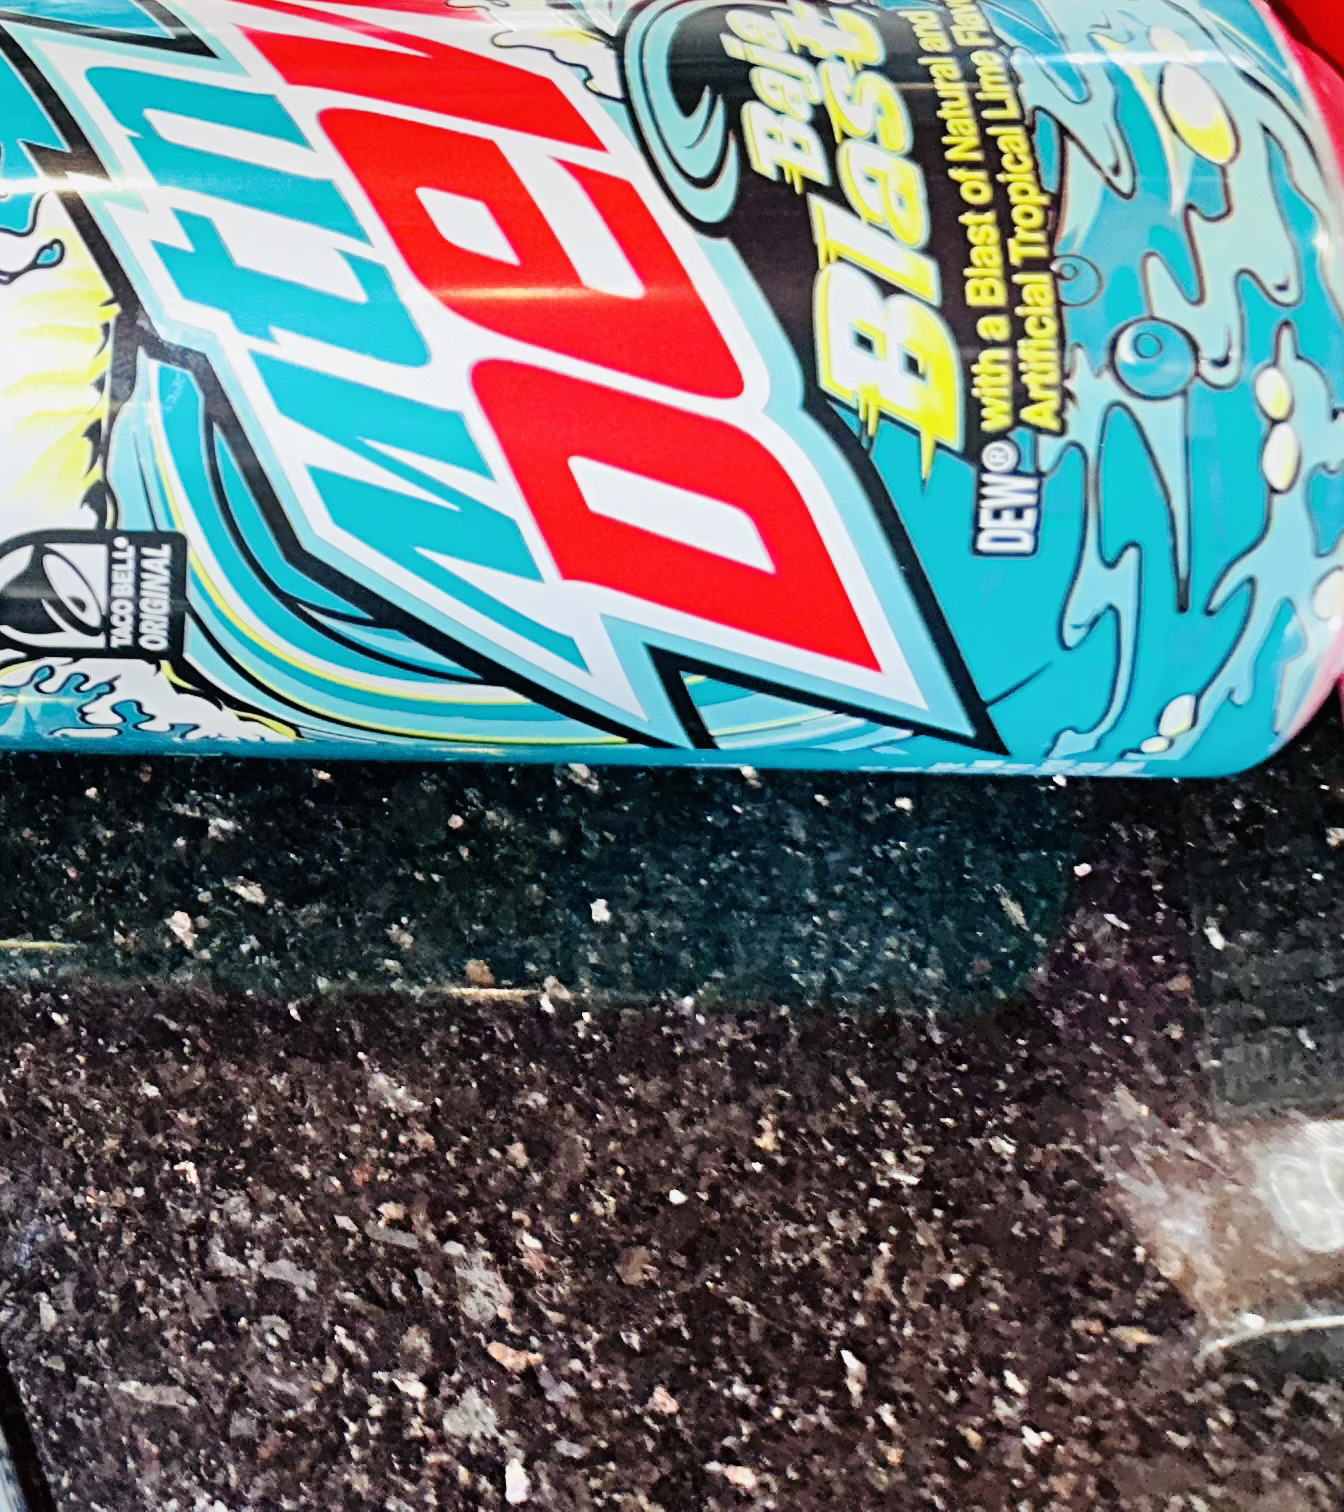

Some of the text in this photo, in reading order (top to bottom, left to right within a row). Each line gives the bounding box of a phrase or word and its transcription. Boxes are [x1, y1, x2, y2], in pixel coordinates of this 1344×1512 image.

[723, 6, 831, 193] Baja
[971, 44, 1020, 124] Lime
[988, 124, 1051, 264] Tropical
[900, 8, 1040, 556] DEW with a Blast of Natural and
[1013, 269, 1063, 434] Artificial
[110, 544, 136, 649] TACO BELL
[138, 543, 171, 652] ORIGINAL
